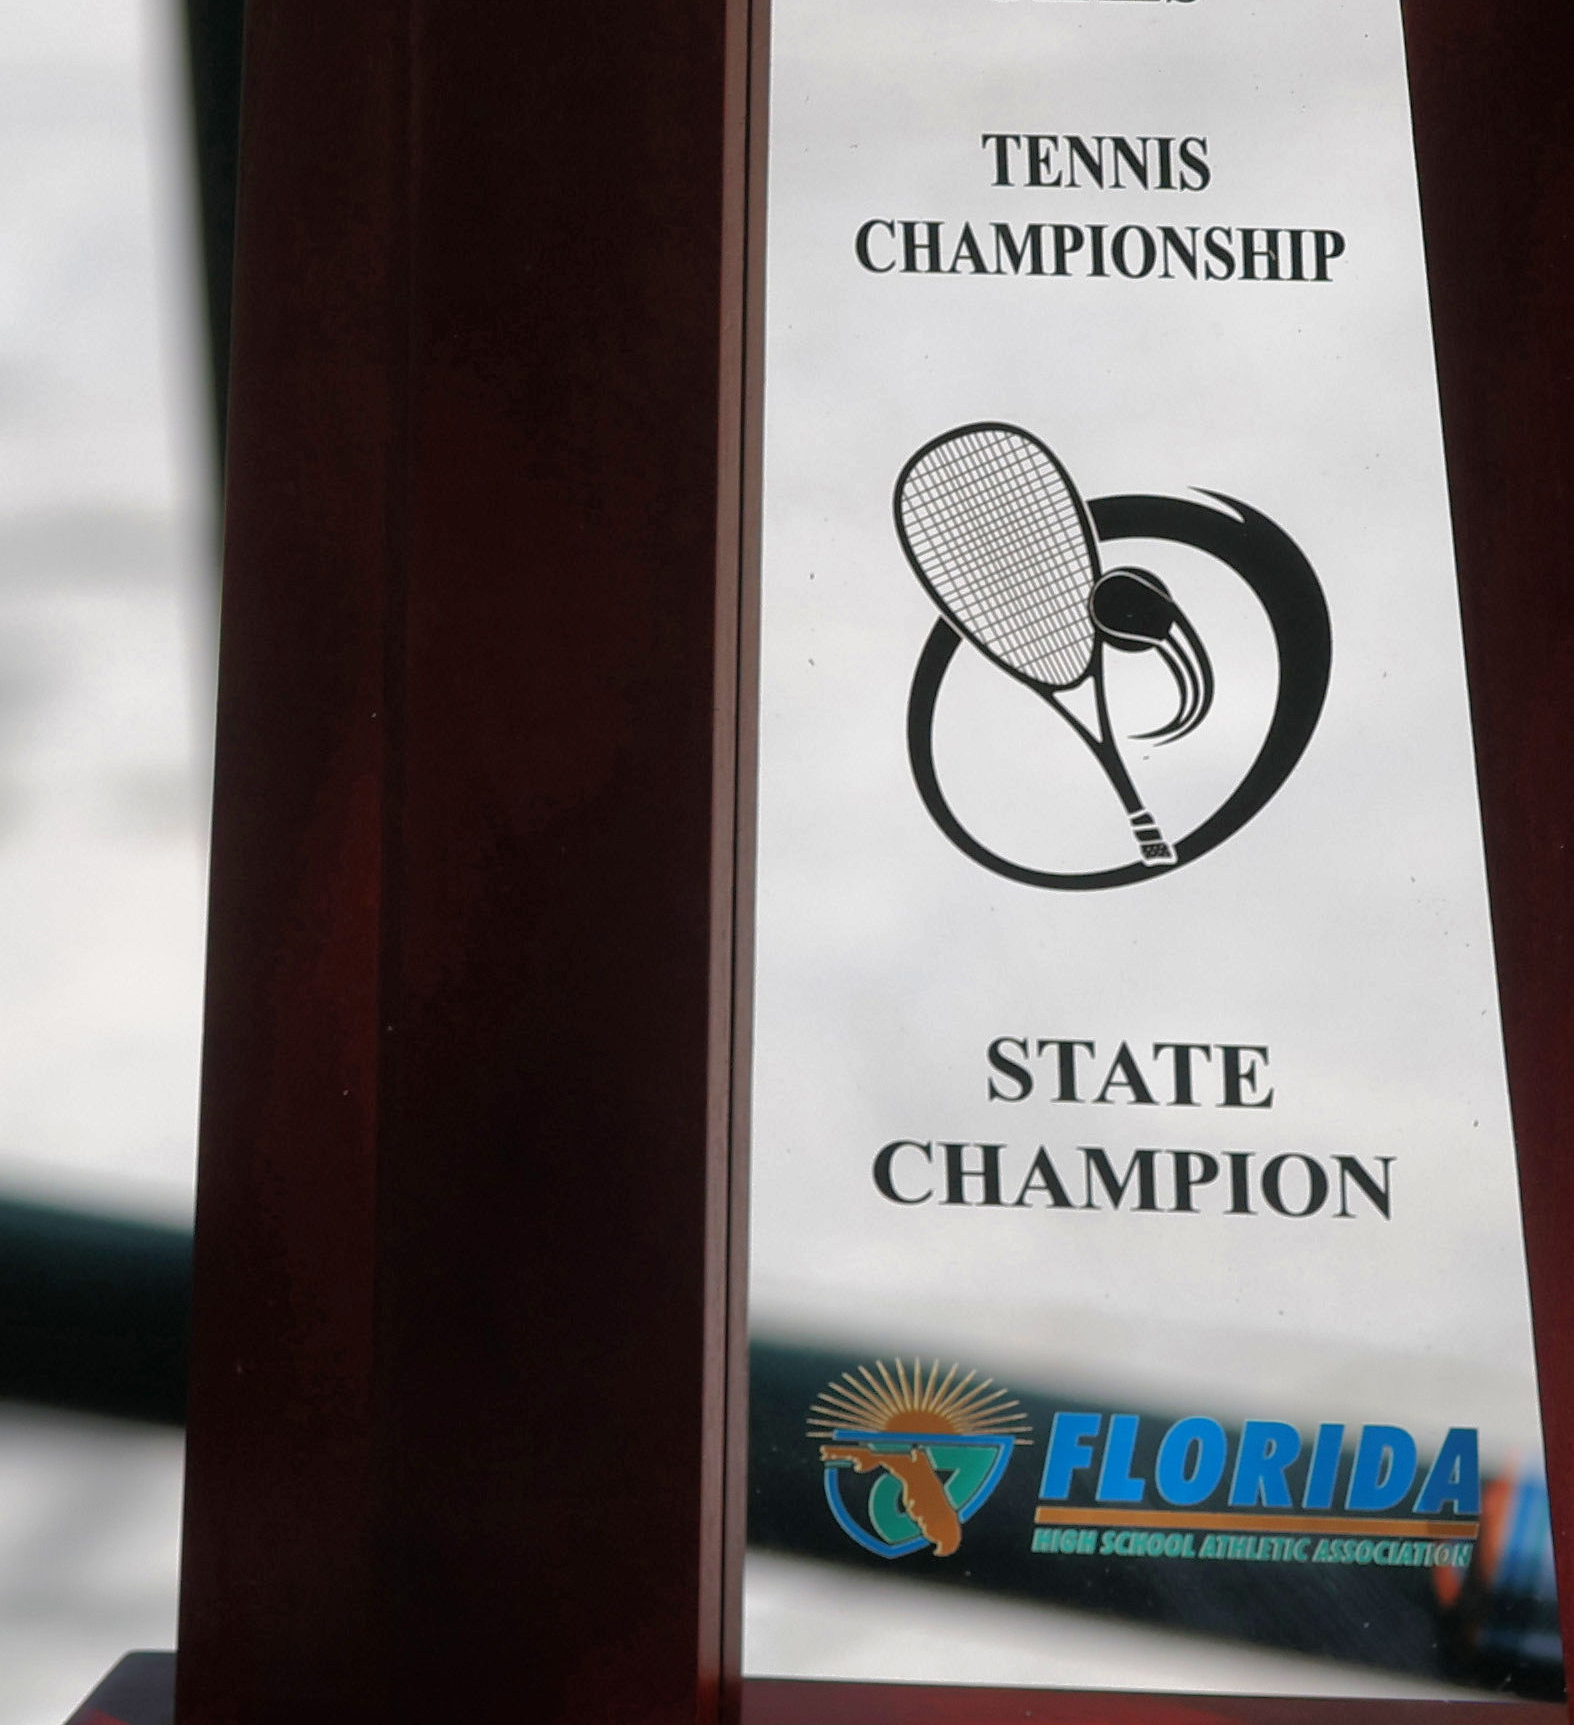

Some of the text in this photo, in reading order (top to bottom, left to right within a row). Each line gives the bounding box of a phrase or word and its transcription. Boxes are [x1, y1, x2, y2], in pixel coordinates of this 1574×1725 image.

[982, 134, 1211, 191] TENNIS
[855, 219, 1345, 282] CHAMPIONSHIP
[987, 1037, 1275, 1108] STATE
[873, 1140, 1397, 1221] CHAMPION
[1039, 1411, 1482, 1514] FLORIDA
[1031, 1528, 1472, 1567] HIGH SCHOOL ATHLETIC ASSOCIATION
